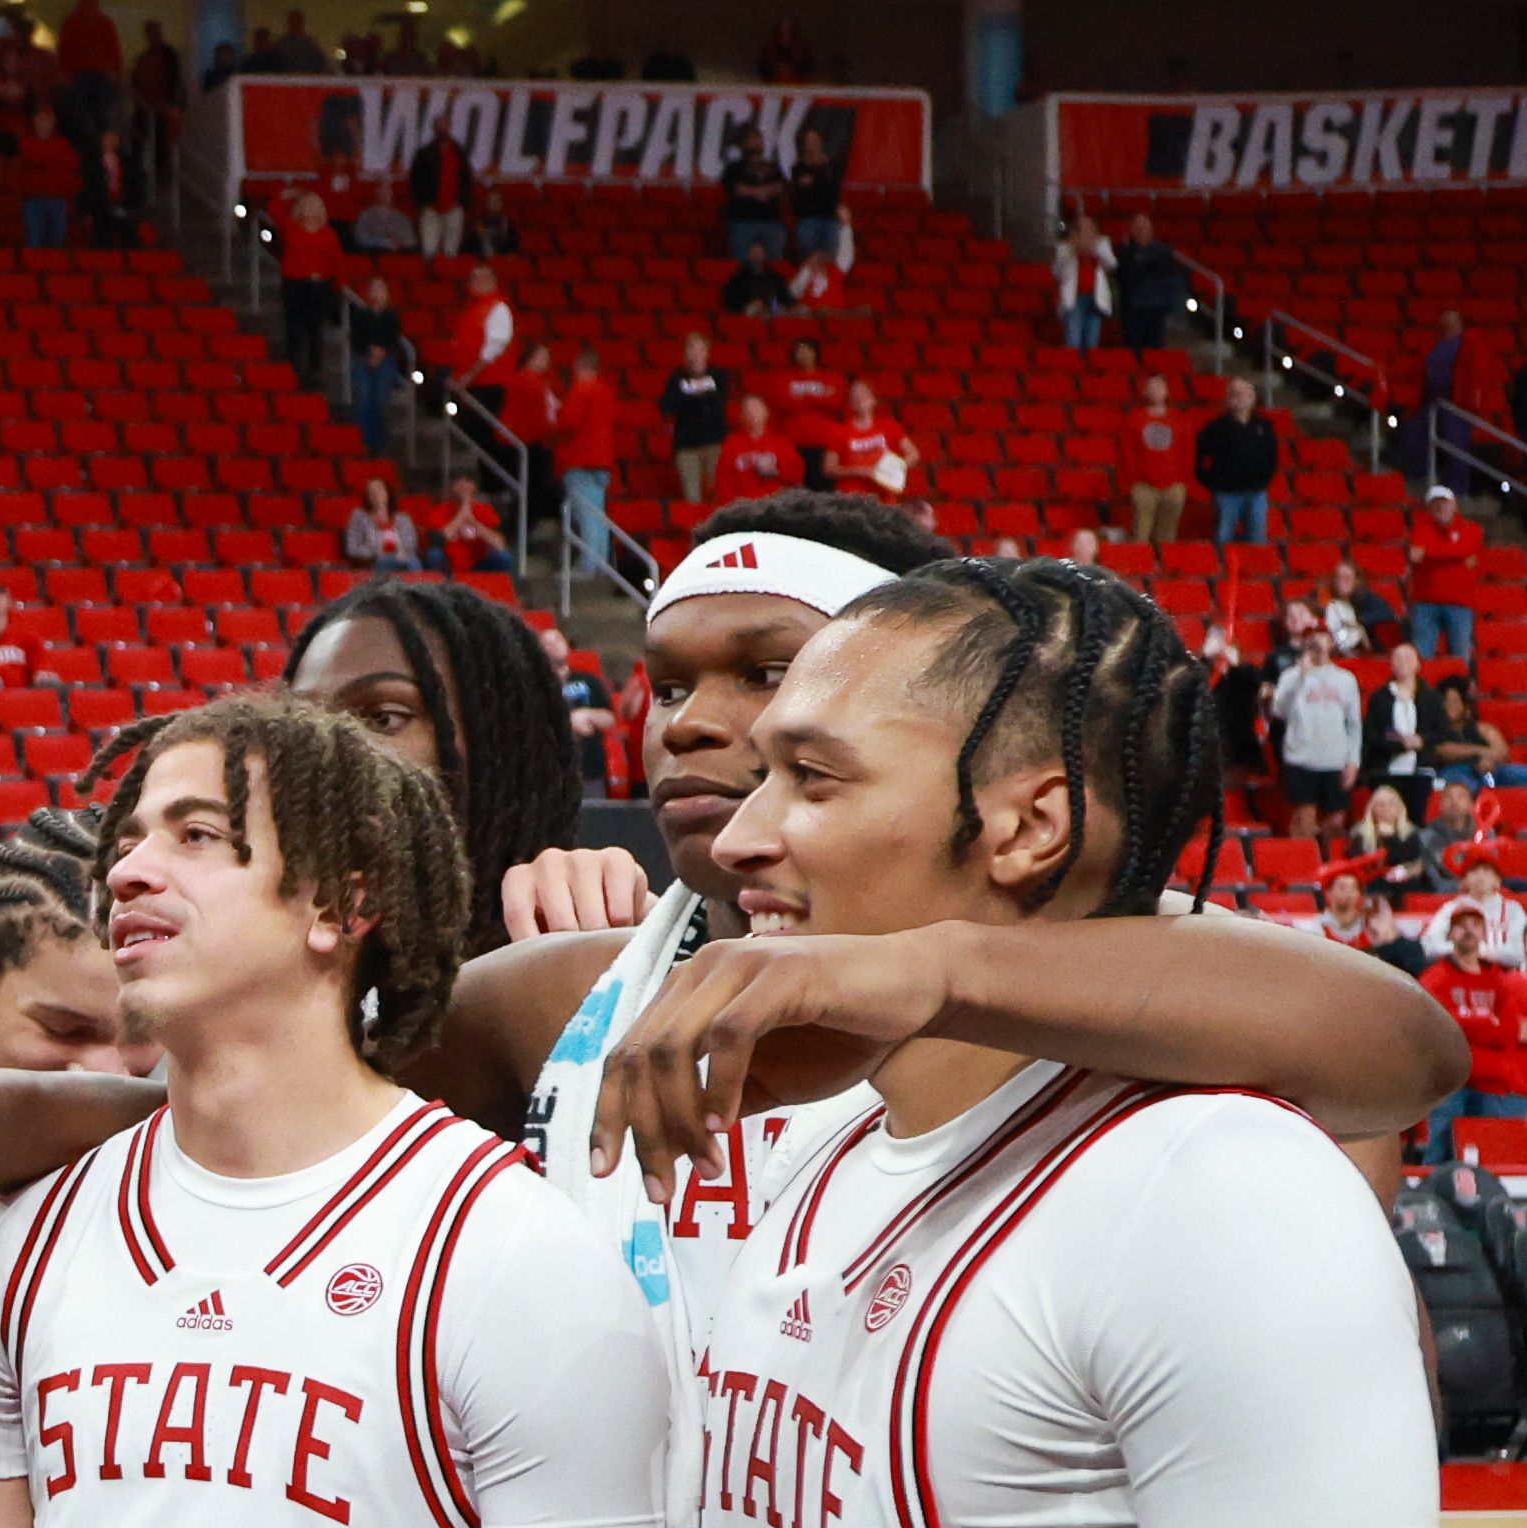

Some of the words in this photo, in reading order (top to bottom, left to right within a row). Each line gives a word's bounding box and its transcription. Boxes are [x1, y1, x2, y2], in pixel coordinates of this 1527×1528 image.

[360, 88, 812, 180] WOLFPACK
[176, 1314, 234, 1331] adidas
[779, 1320, 813, 1344] adidas
[37, 1362, 365, 1526] STATE
